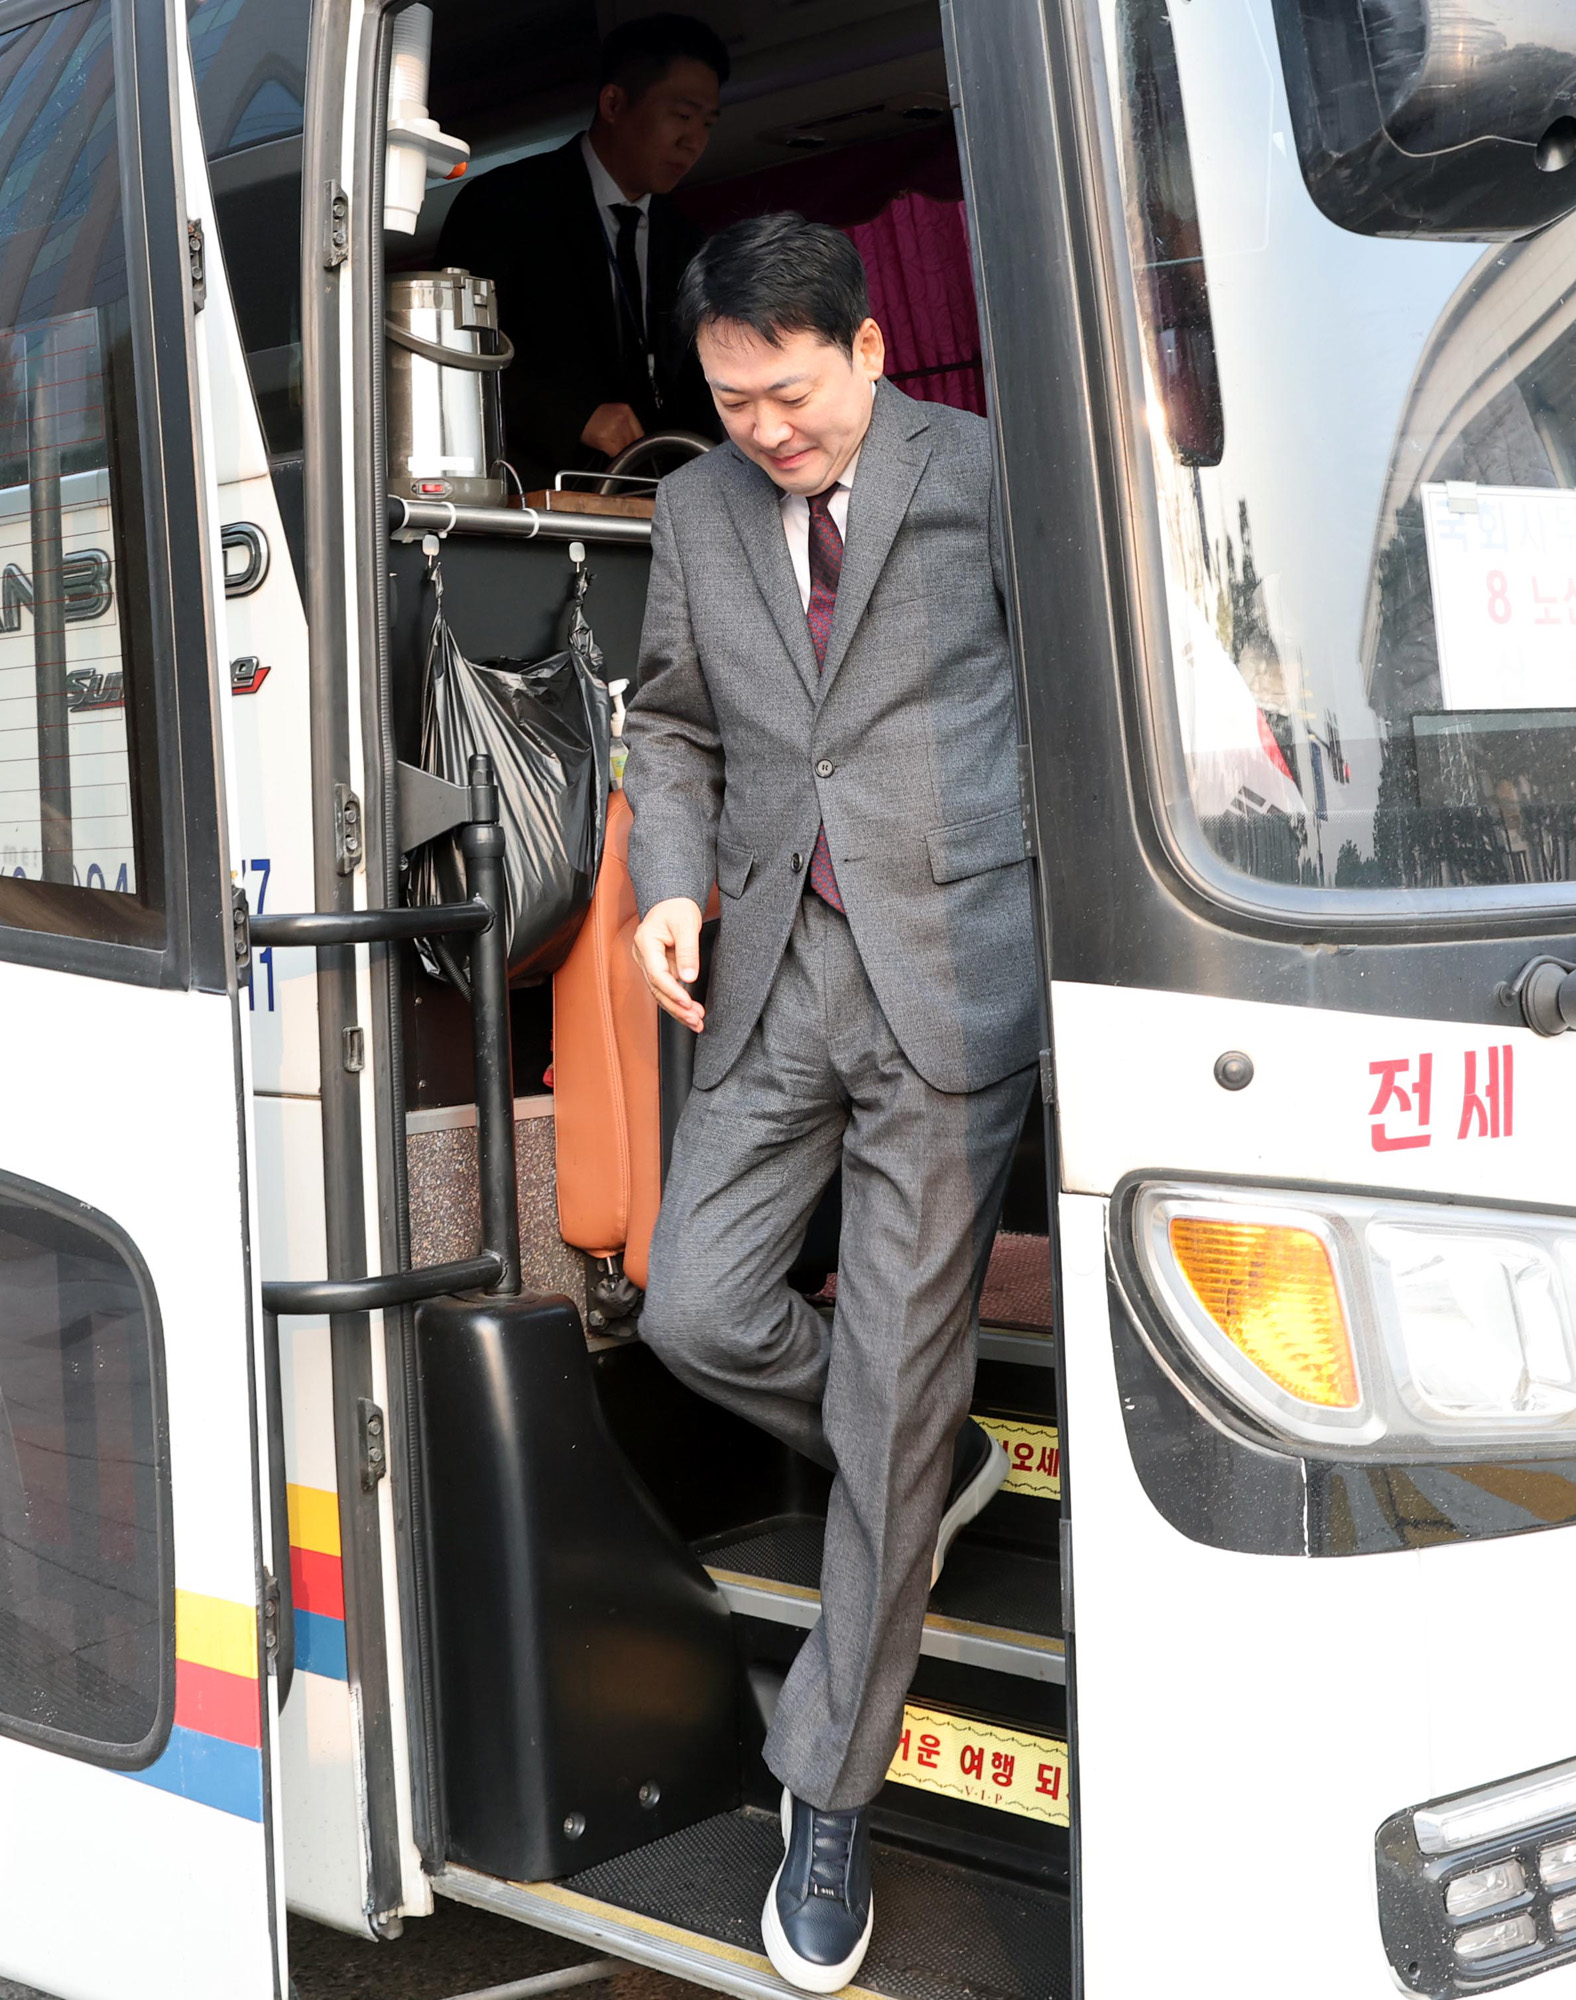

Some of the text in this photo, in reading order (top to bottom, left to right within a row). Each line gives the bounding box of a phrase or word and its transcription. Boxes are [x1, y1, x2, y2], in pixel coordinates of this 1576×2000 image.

[1485, 569, 1513, 625] 8
[1002, 1440, 1060, 1478] 오세
[960, 1744, 1015, 1787] 여행
